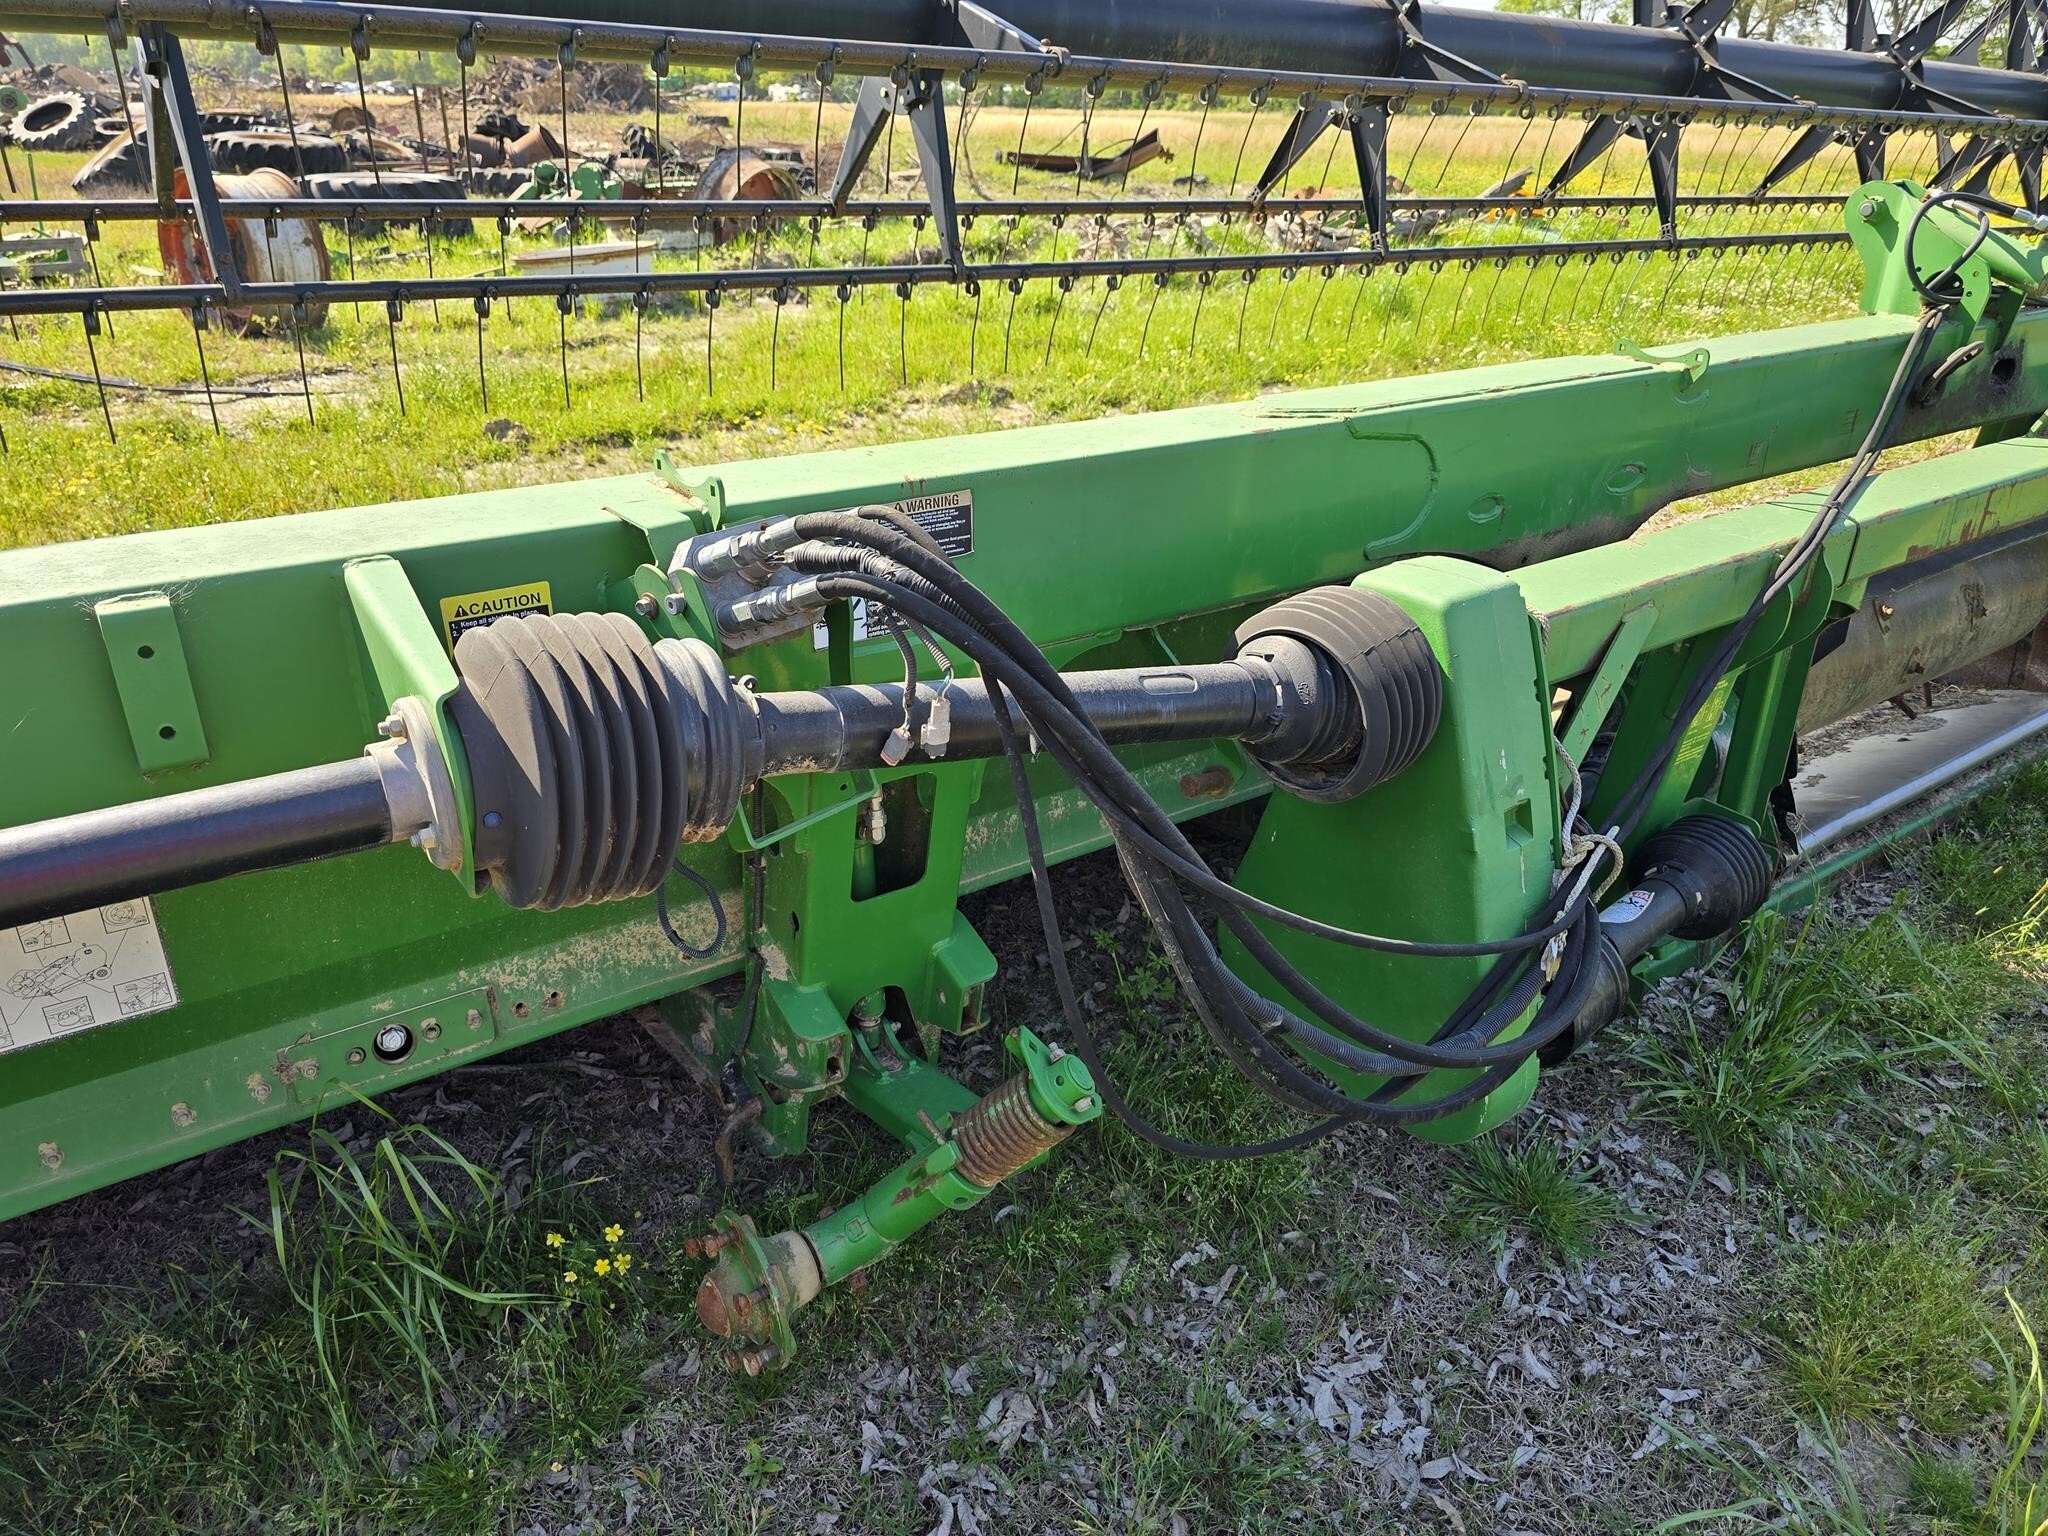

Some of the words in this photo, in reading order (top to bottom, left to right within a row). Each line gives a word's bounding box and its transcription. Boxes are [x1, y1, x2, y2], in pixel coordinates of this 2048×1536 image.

[906, 494, 959, 512] WARNING
[469, 592, 541, 615] CAUTION
[460, 619, 478, 628] Keep
